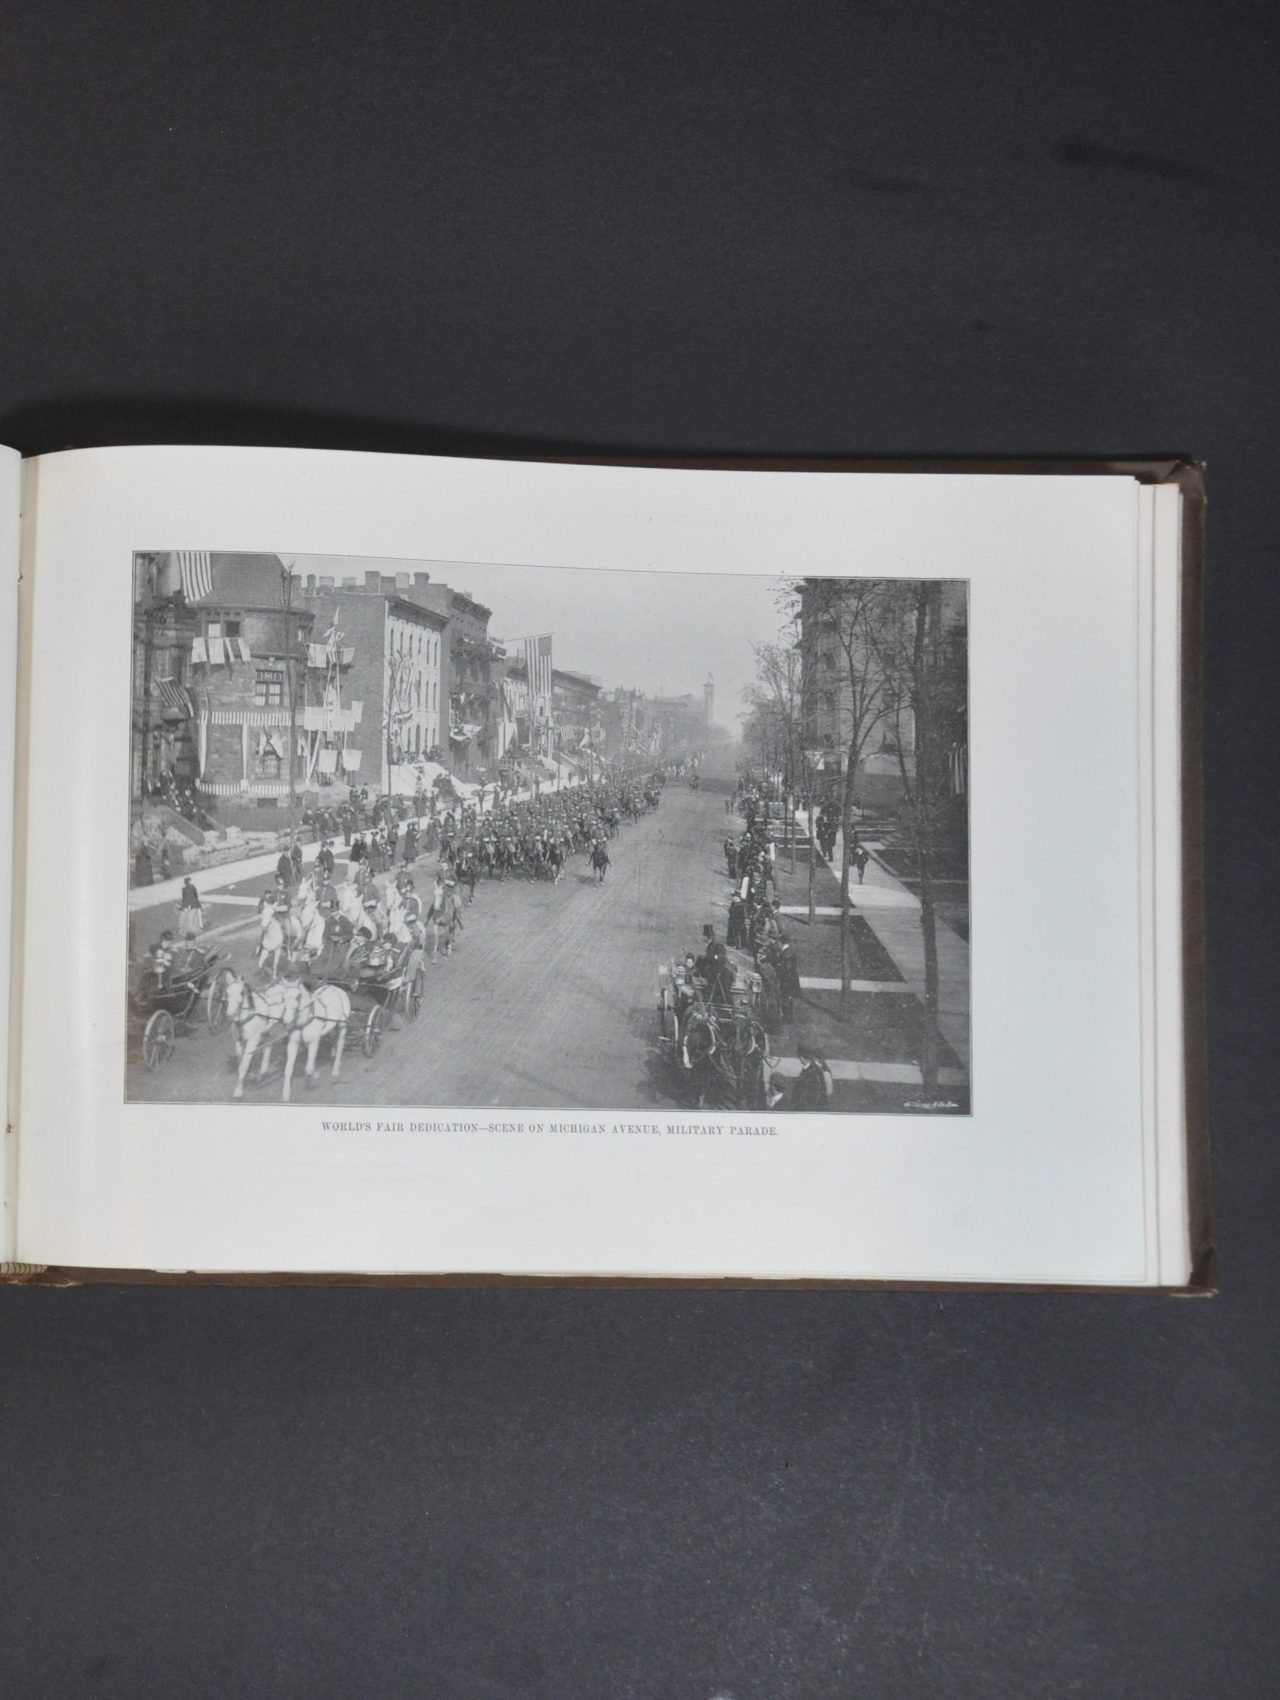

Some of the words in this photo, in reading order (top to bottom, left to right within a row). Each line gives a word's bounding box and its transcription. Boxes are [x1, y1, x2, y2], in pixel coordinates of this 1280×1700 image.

[322, 1122, 371, 1131] WORLD'S
[377, 1122, 404, 1132] FAIR
[528, 1123, 544, 1132] ON
[549, 1124, 606, 1133] MICHIGAN
[611, 1125, 661, 1136] AVENUE,
[667, 1125, 724, 1135] MILITARY
[730, 1127, 779, 1136] PARADE.
